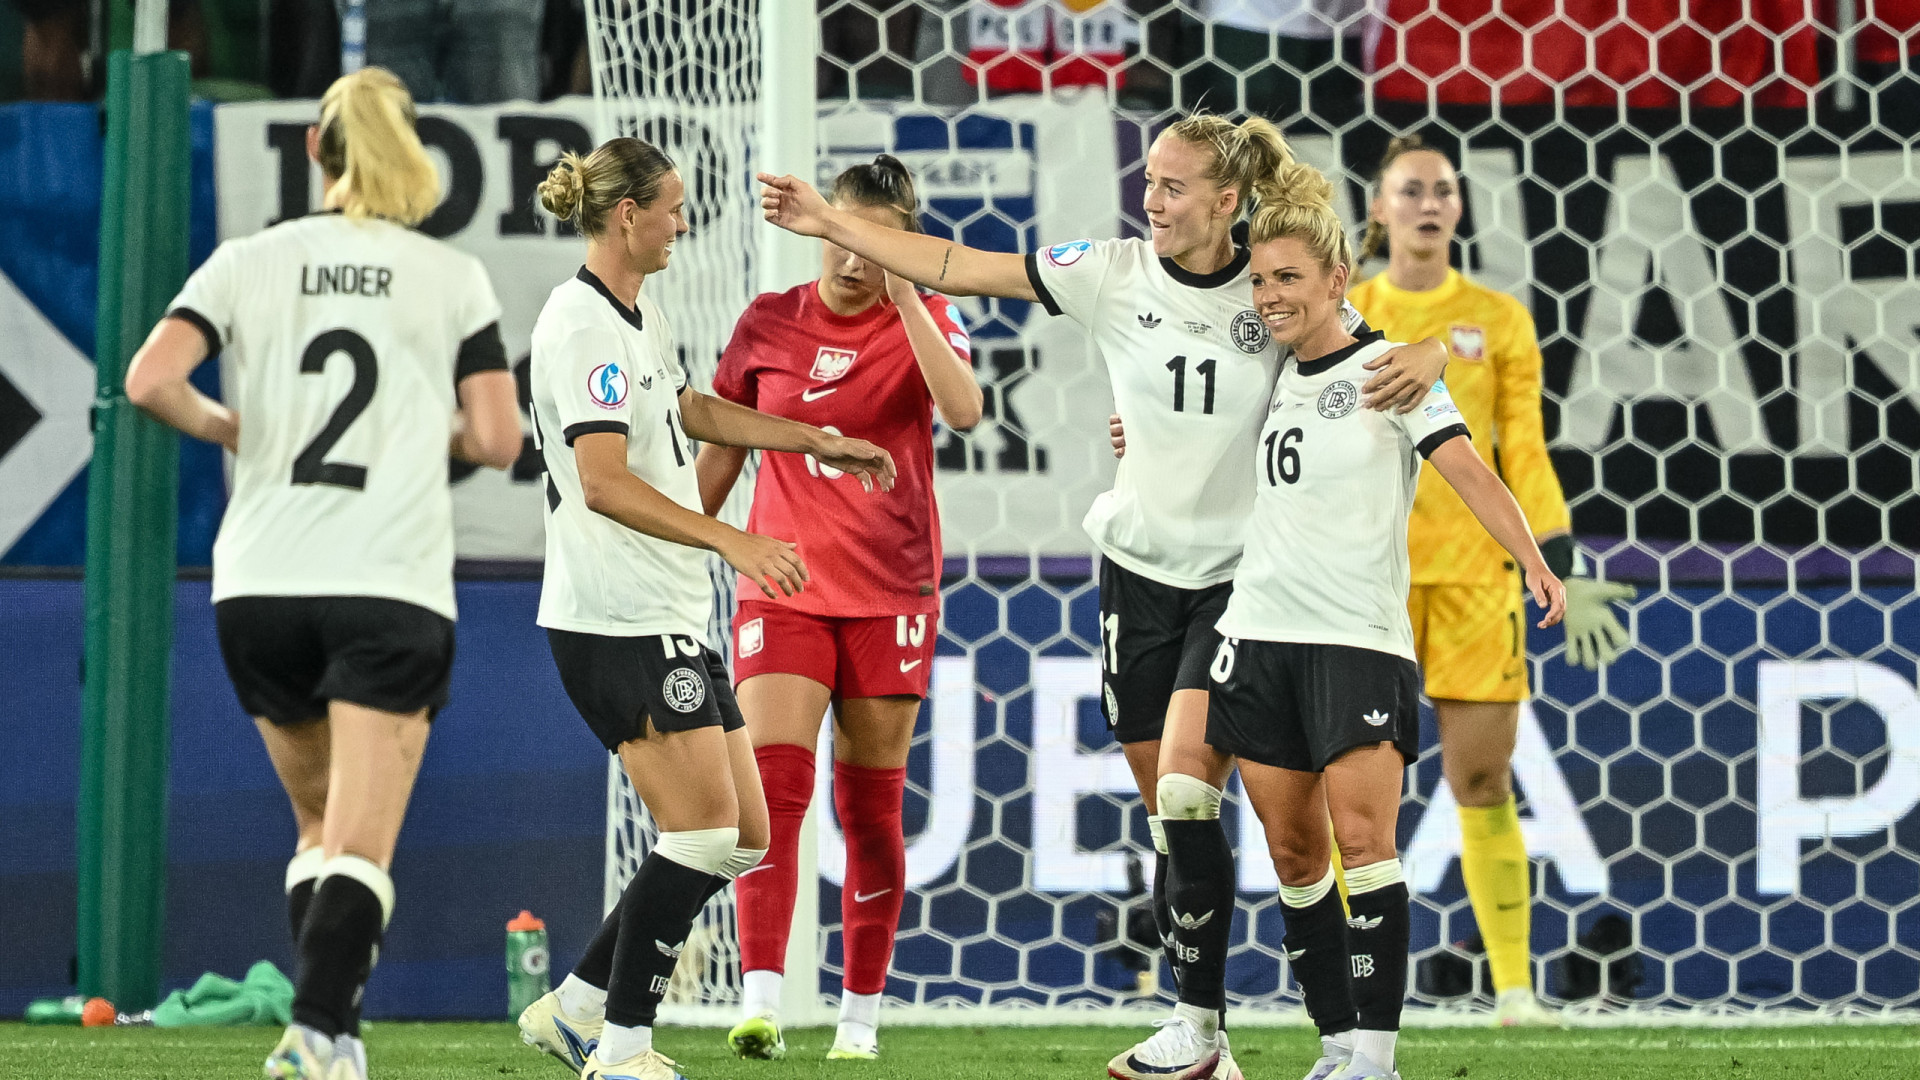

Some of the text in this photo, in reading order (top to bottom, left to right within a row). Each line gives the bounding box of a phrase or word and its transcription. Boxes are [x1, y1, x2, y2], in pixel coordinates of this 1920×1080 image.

[301, 264, 392, 297] LINDER
[290, 327, 379, 491] 2
[1165, 355, 1217, 415] 11
[1264, 427, 1304, 487] 16
[816, 656, 1608, 893] UEA
